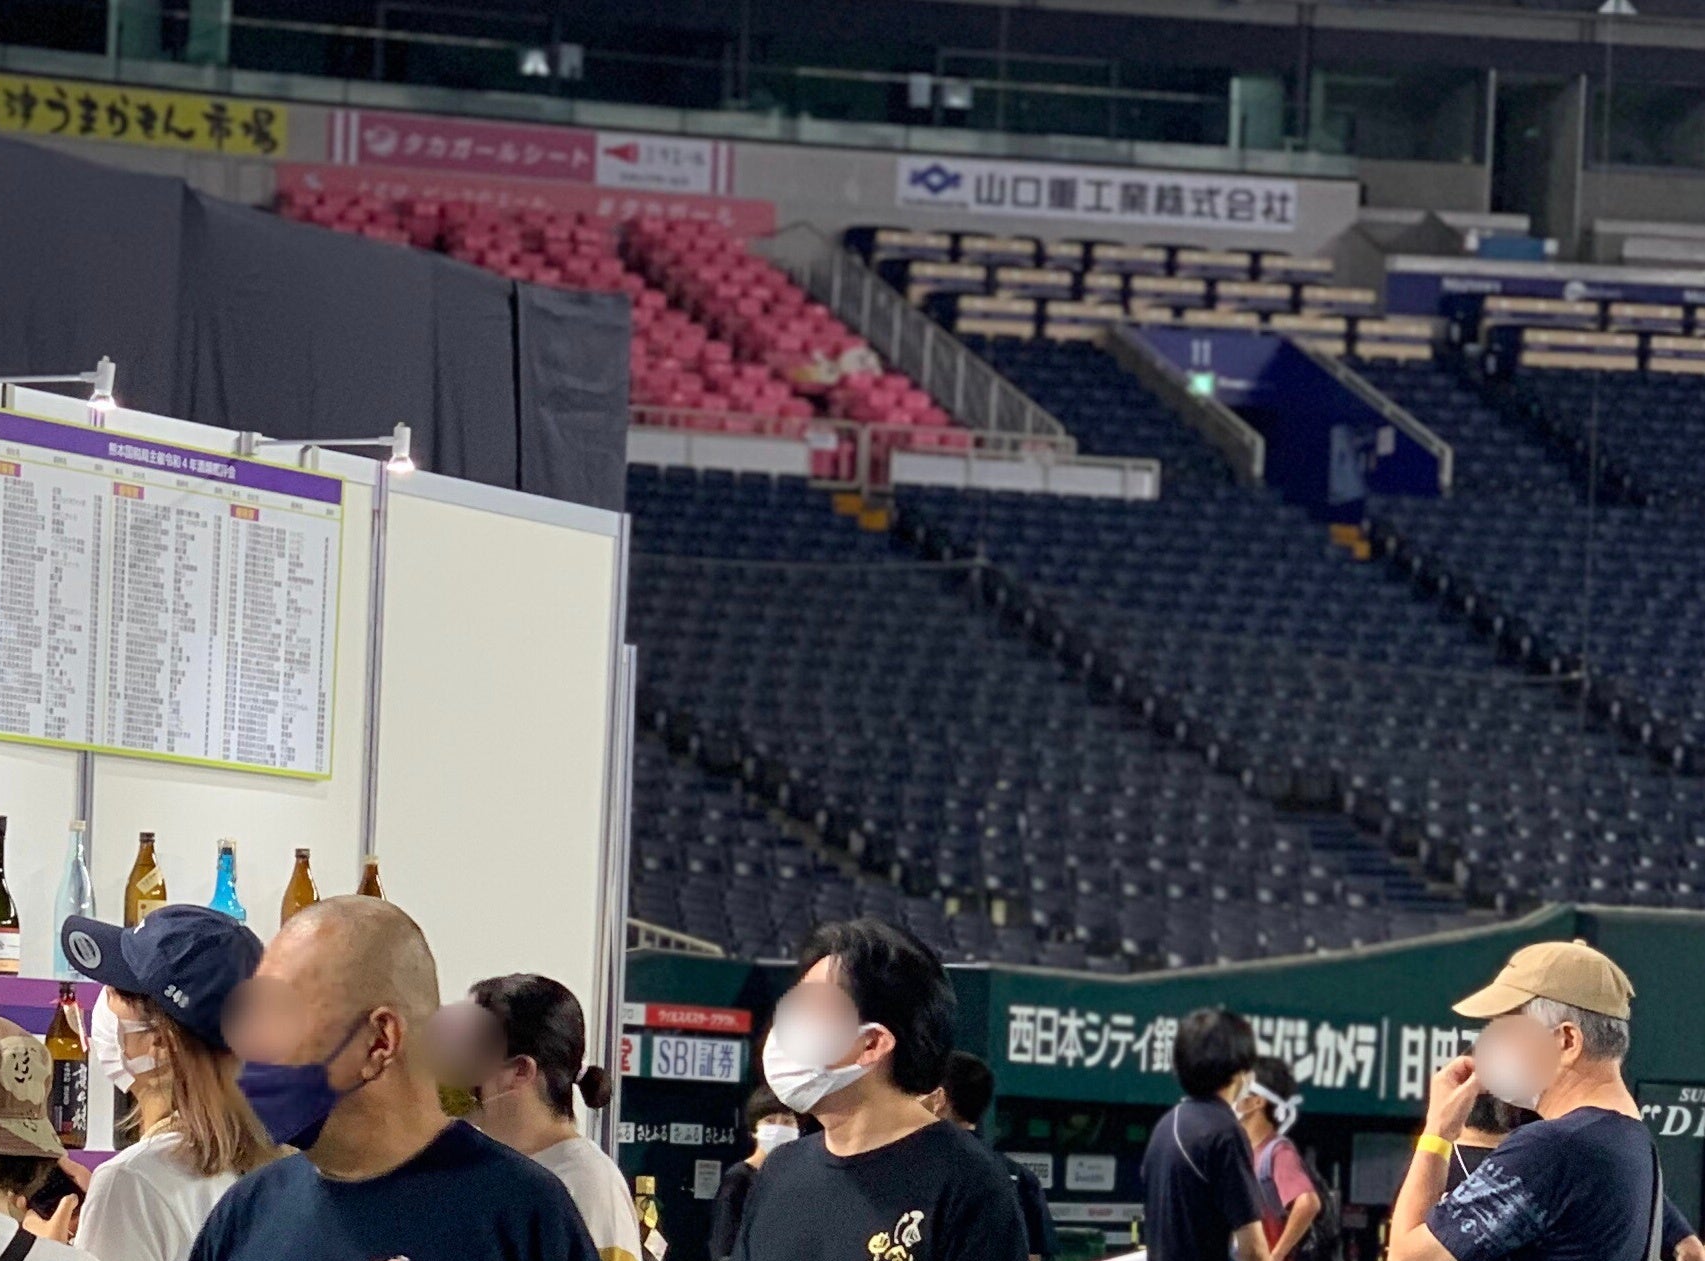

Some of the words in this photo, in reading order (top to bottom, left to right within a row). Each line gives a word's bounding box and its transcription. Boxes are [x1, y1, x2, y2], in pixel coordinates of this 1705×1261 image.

[974, 172, 1293, 226] 山口重工業株式会社
[1246, 1014, 1377, 1090] ドバシカメラ
